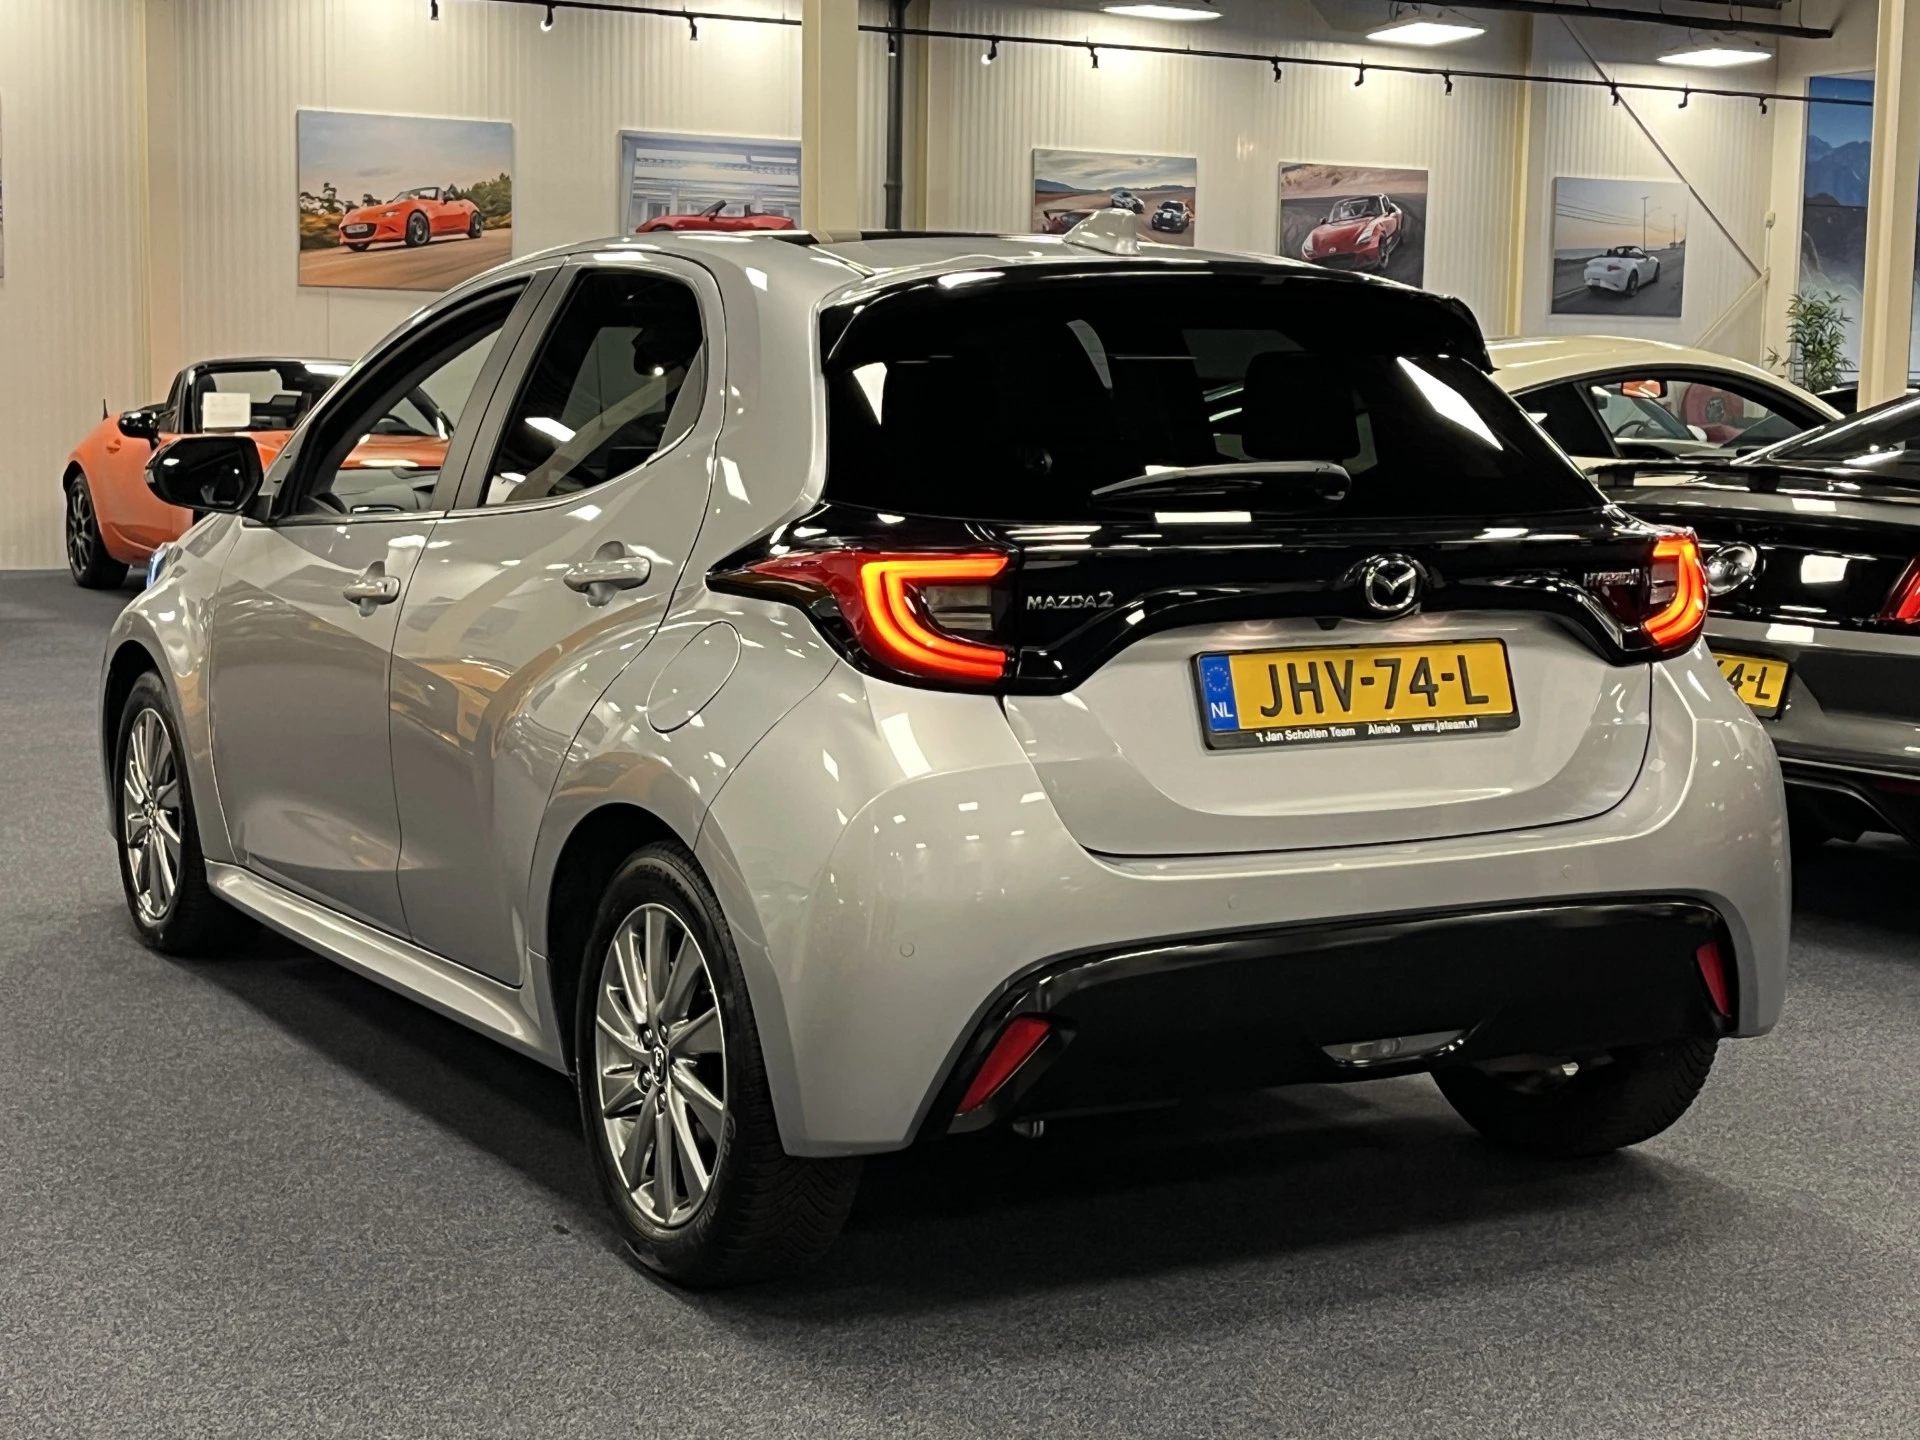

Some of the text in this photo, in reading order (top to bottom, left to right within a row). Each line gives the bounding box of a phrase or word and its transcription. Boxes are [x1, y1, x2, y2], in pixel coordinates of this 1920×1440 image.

[1260, 654, 1490, 718] JHV-74-L
[1716, 660, 1771, 700] 4-L
[1211, 702, 1234, 719] NL
[1265, 731, 1284, 742] Jan
[1285, 728, 1329, 741] Scholten
[1329, 726, 1356, 738] Team
[1368, 723, 1401, 735] Almelo
[1412, 718, 1478, 733] www.jsteam.nl
